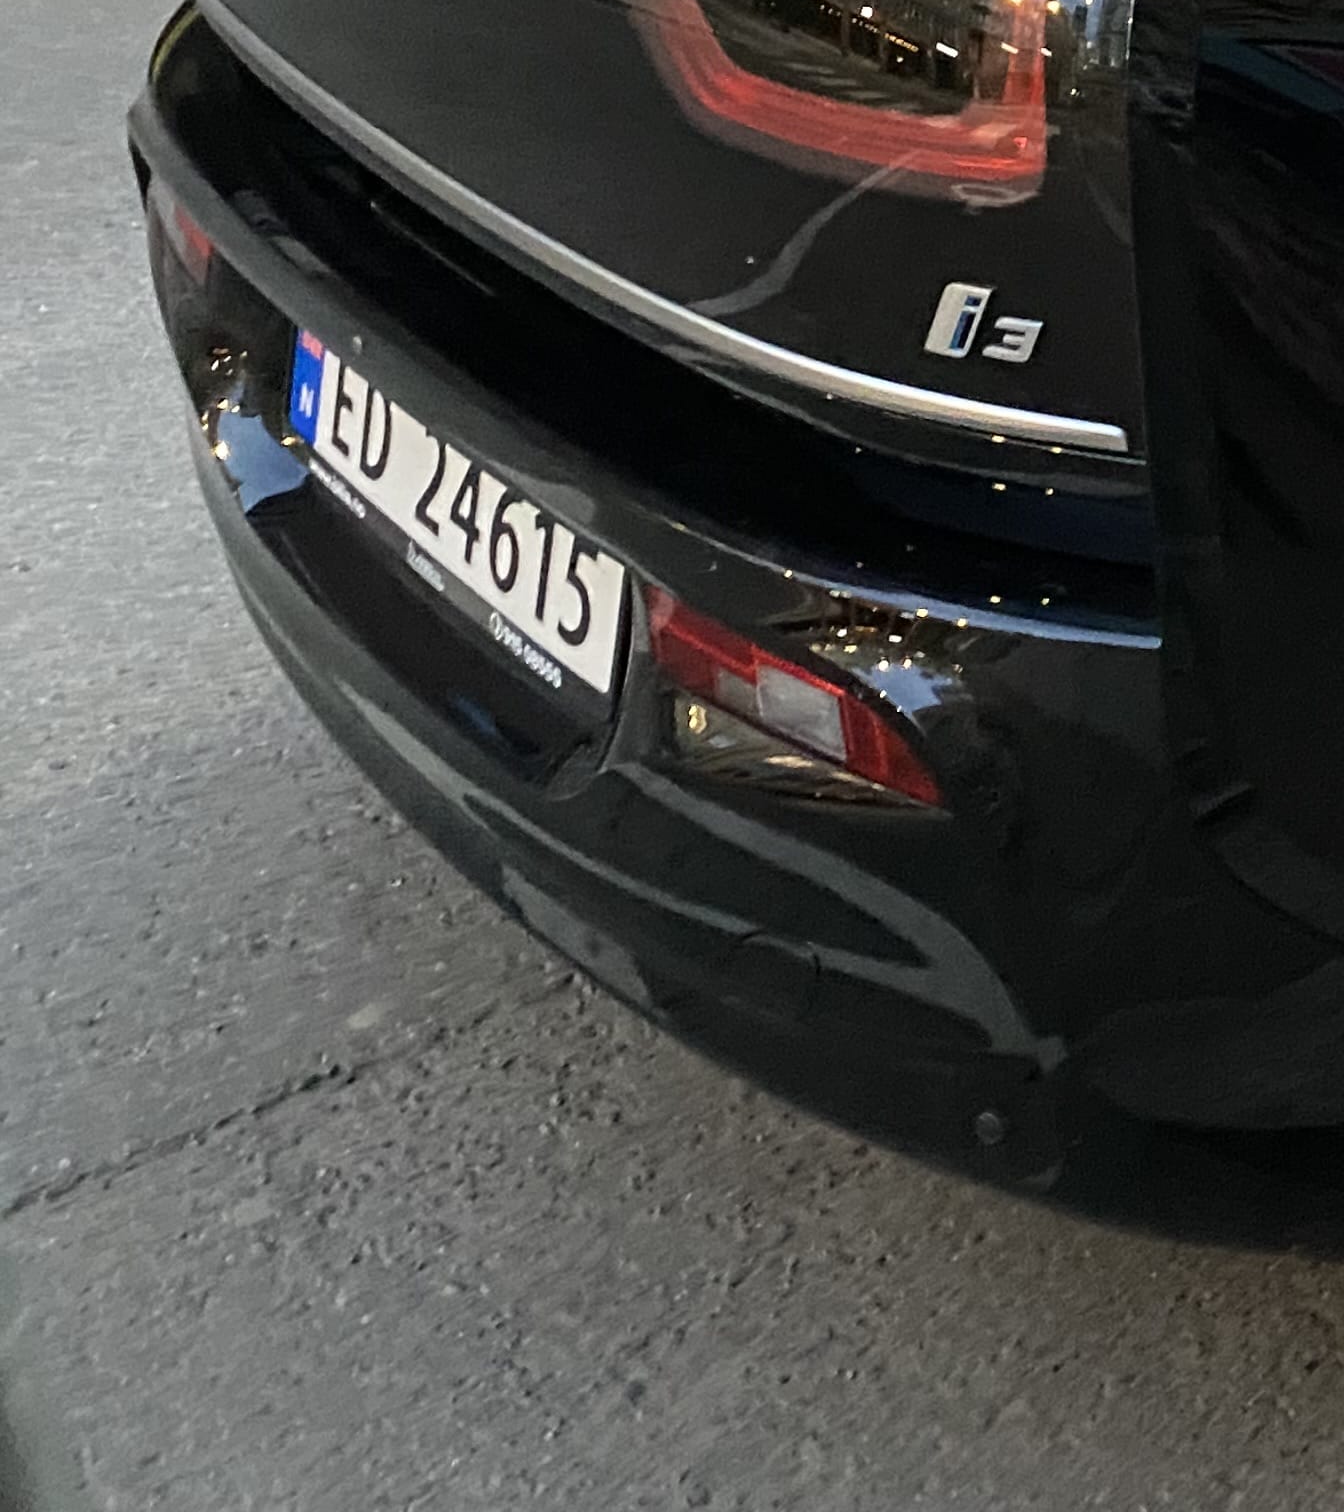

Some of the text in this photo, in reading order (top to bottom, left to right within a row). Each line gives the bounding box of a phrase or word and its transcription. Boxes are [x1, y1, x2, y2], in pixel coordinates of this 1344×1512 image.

[923, 281, 1045, 364] i3
[299, 382, 315, 418] N
[414, 426, 592, 647] 24615
